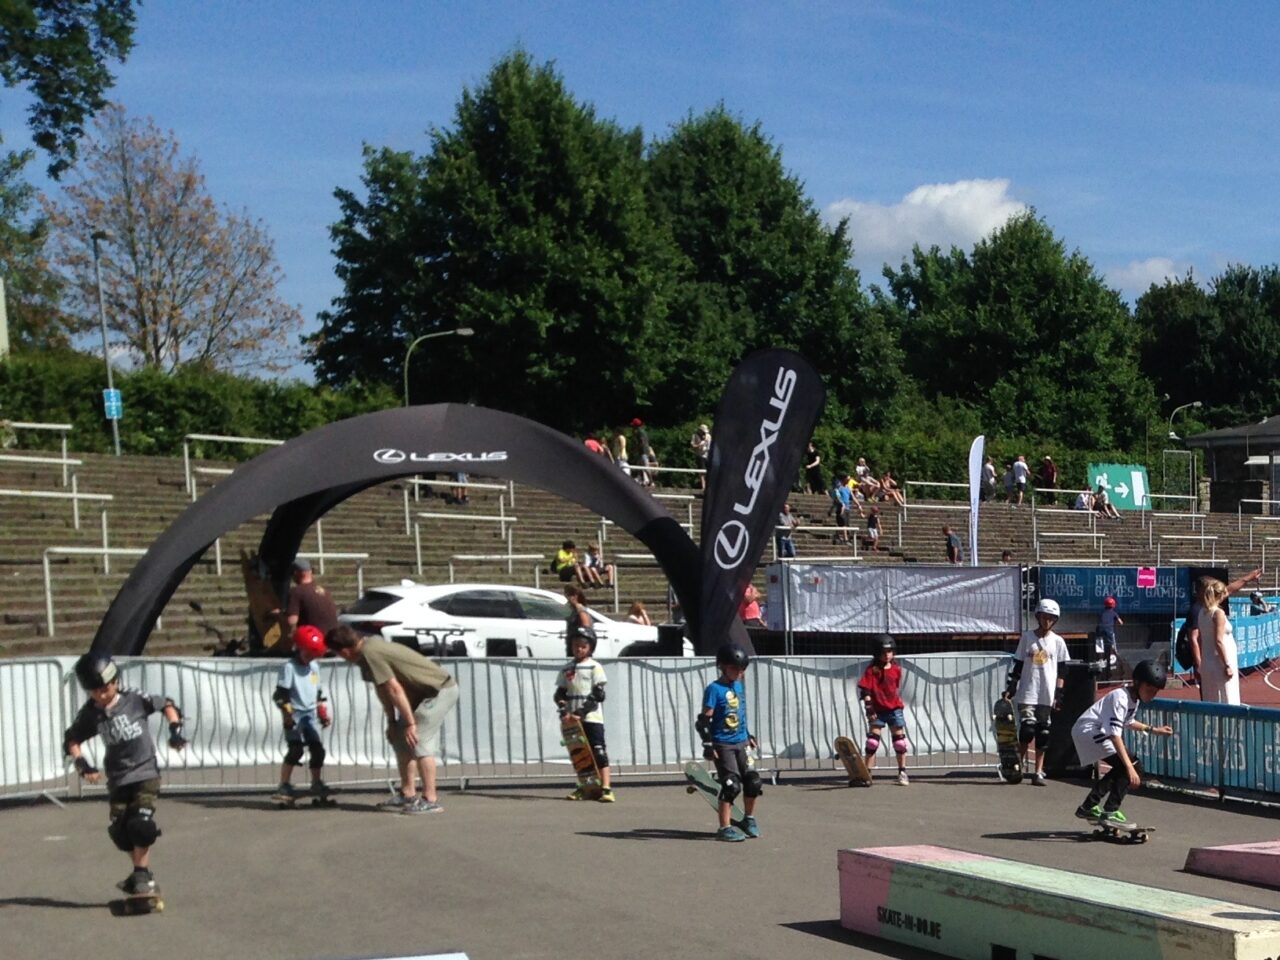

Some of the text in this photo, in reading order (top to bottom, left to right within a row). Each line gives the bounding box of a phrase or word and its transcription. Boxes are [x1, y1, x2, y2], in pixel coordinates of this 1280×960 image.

[733, 366, 797, 515] LEXUS
[410, 451, 508, 461] LEXUS
[1095, 574, 1126, 586] RUHR
[1045, 585, 1084, 597] GAMES
[1095, 586, 1135, 598] GAMES
